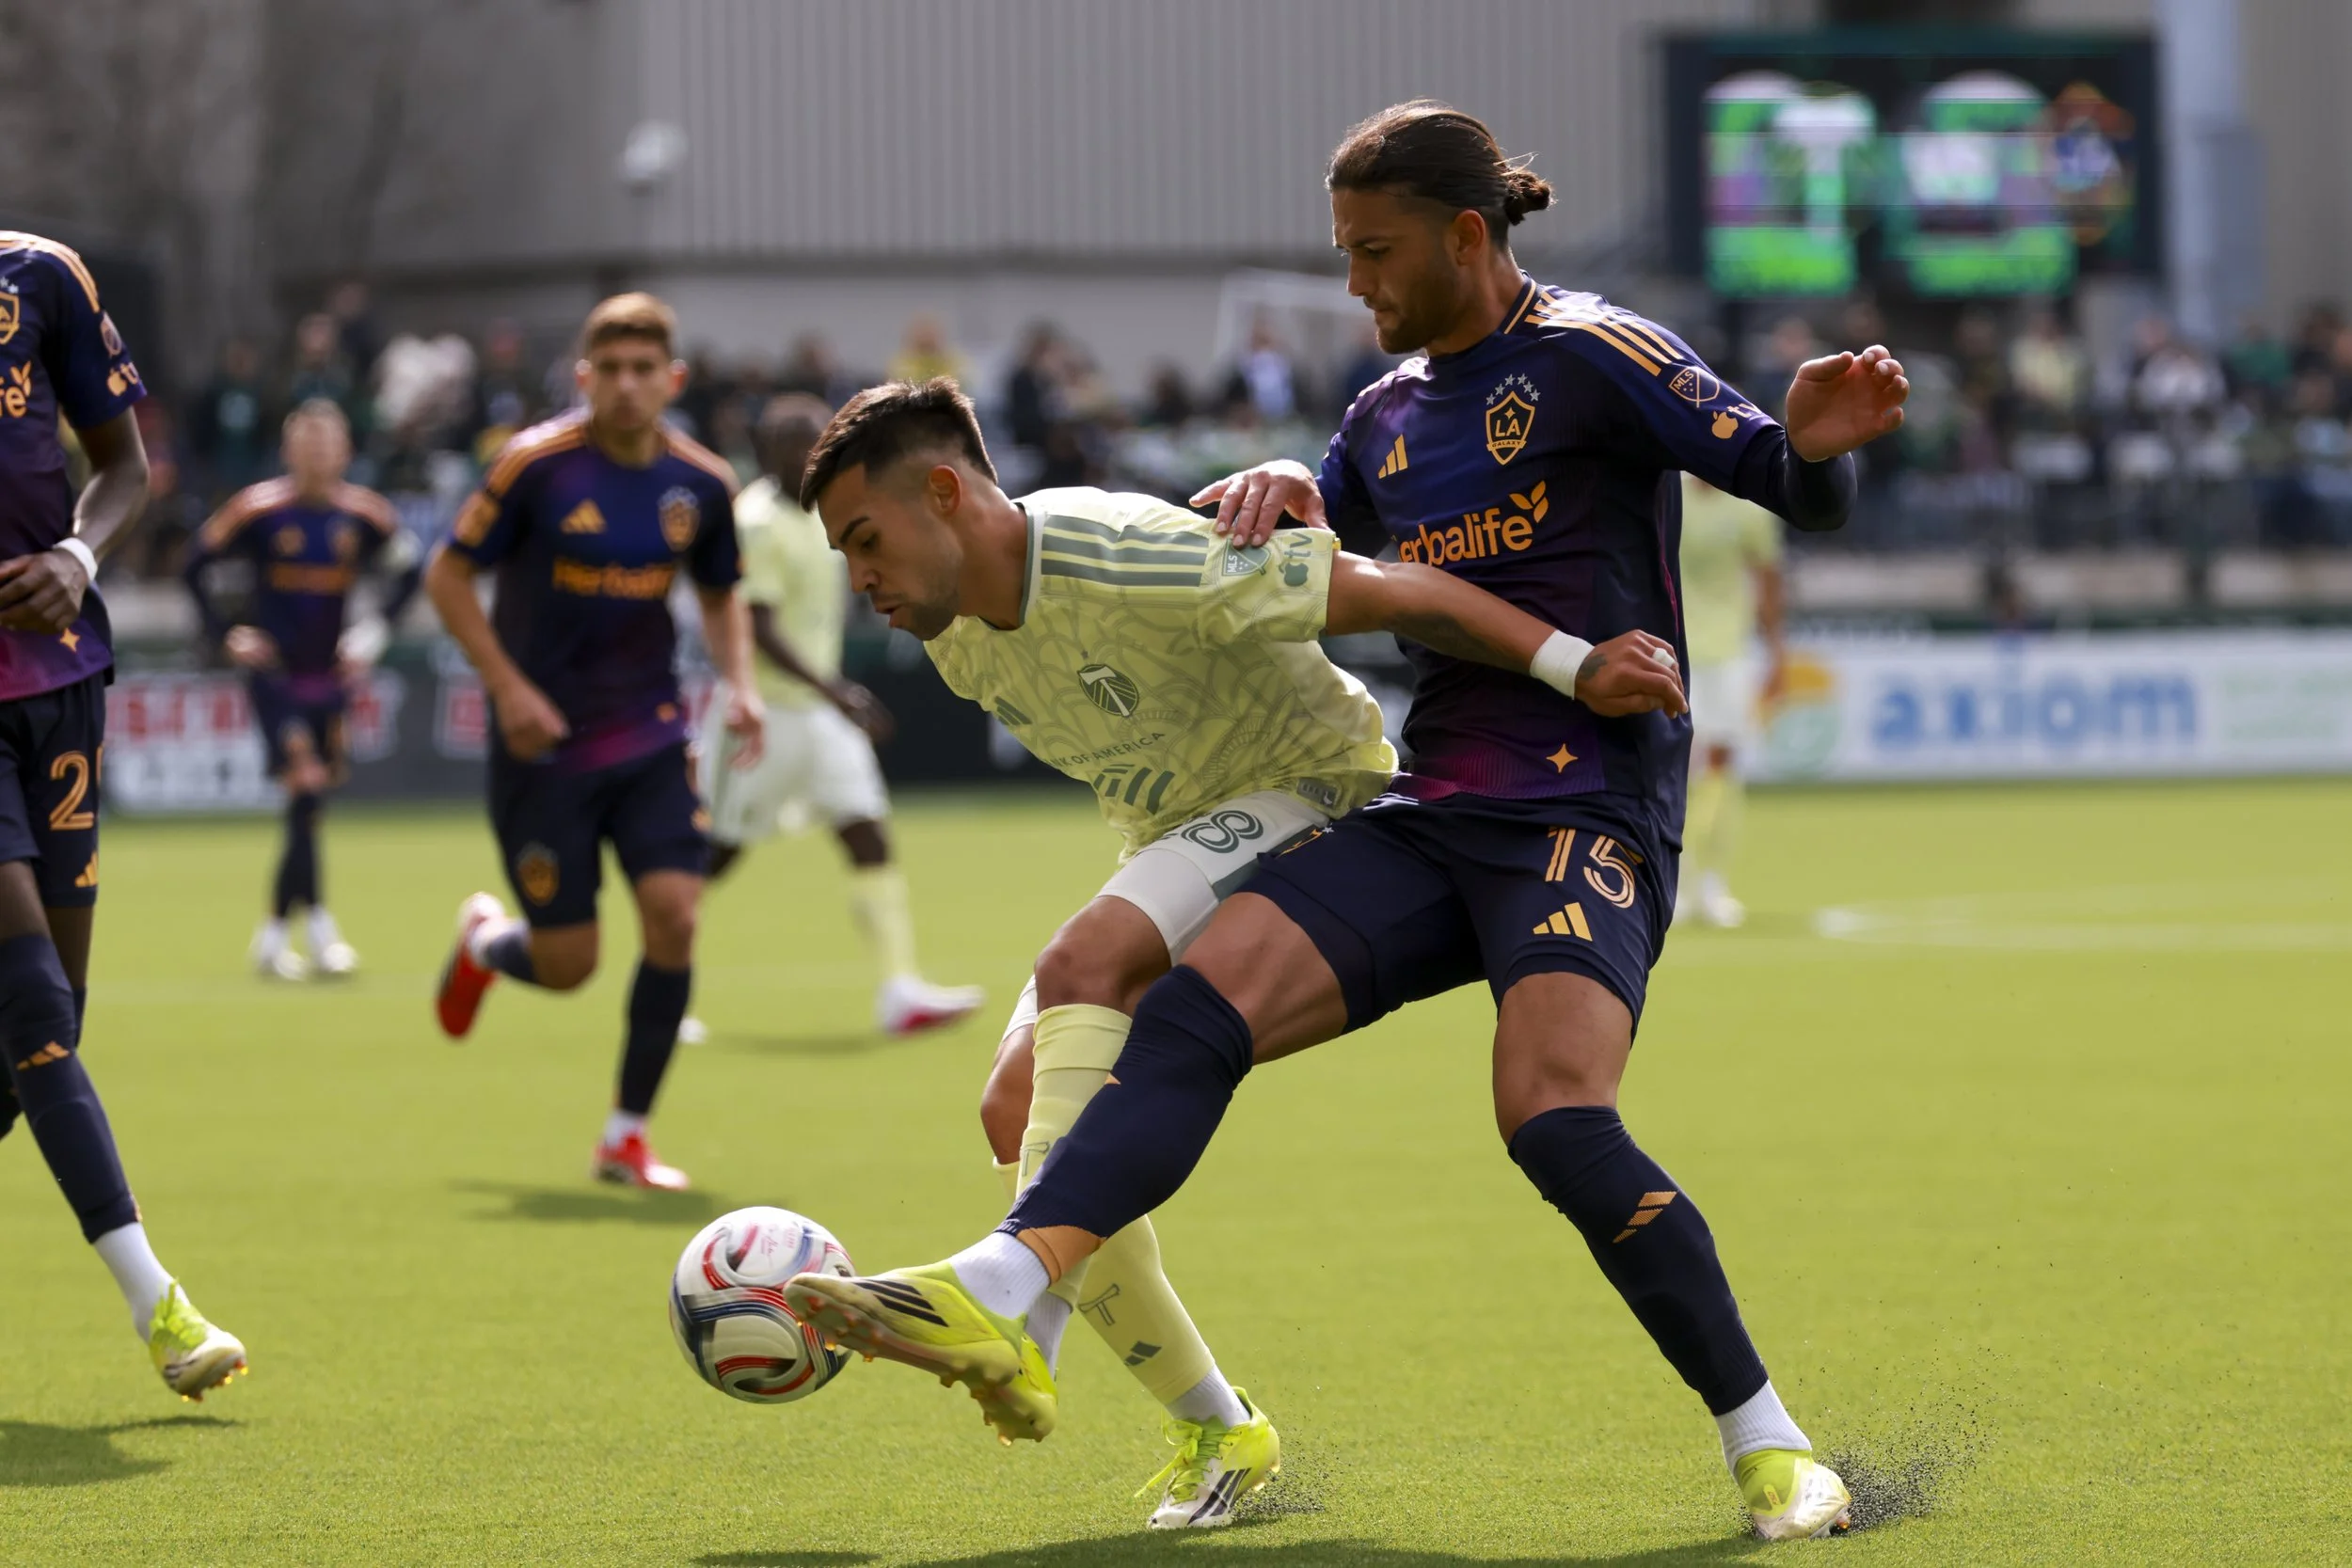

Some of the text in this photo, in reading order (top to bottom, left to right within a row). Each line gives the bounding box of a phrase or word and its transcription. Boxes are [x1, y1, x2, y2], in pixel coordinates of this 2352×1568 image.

[1673, 371, 1694, 390] MLS
[1726, 403, 1767, 421] tv
[1495, 419, 1521, 437] LA
[1283, 531, 1313, 558] tv
[1398, 507, 1534, 566] erbalife
[1227, 554, 1239, 573] MLS
[1071, 753, 1090, 765] OF
[1091, 732, 1166, 761] AMERICA
[50, 746, 103, 831] 2
[1161, 810, 1264, 854] 8
[1544, 826, 1645, 910] 15
